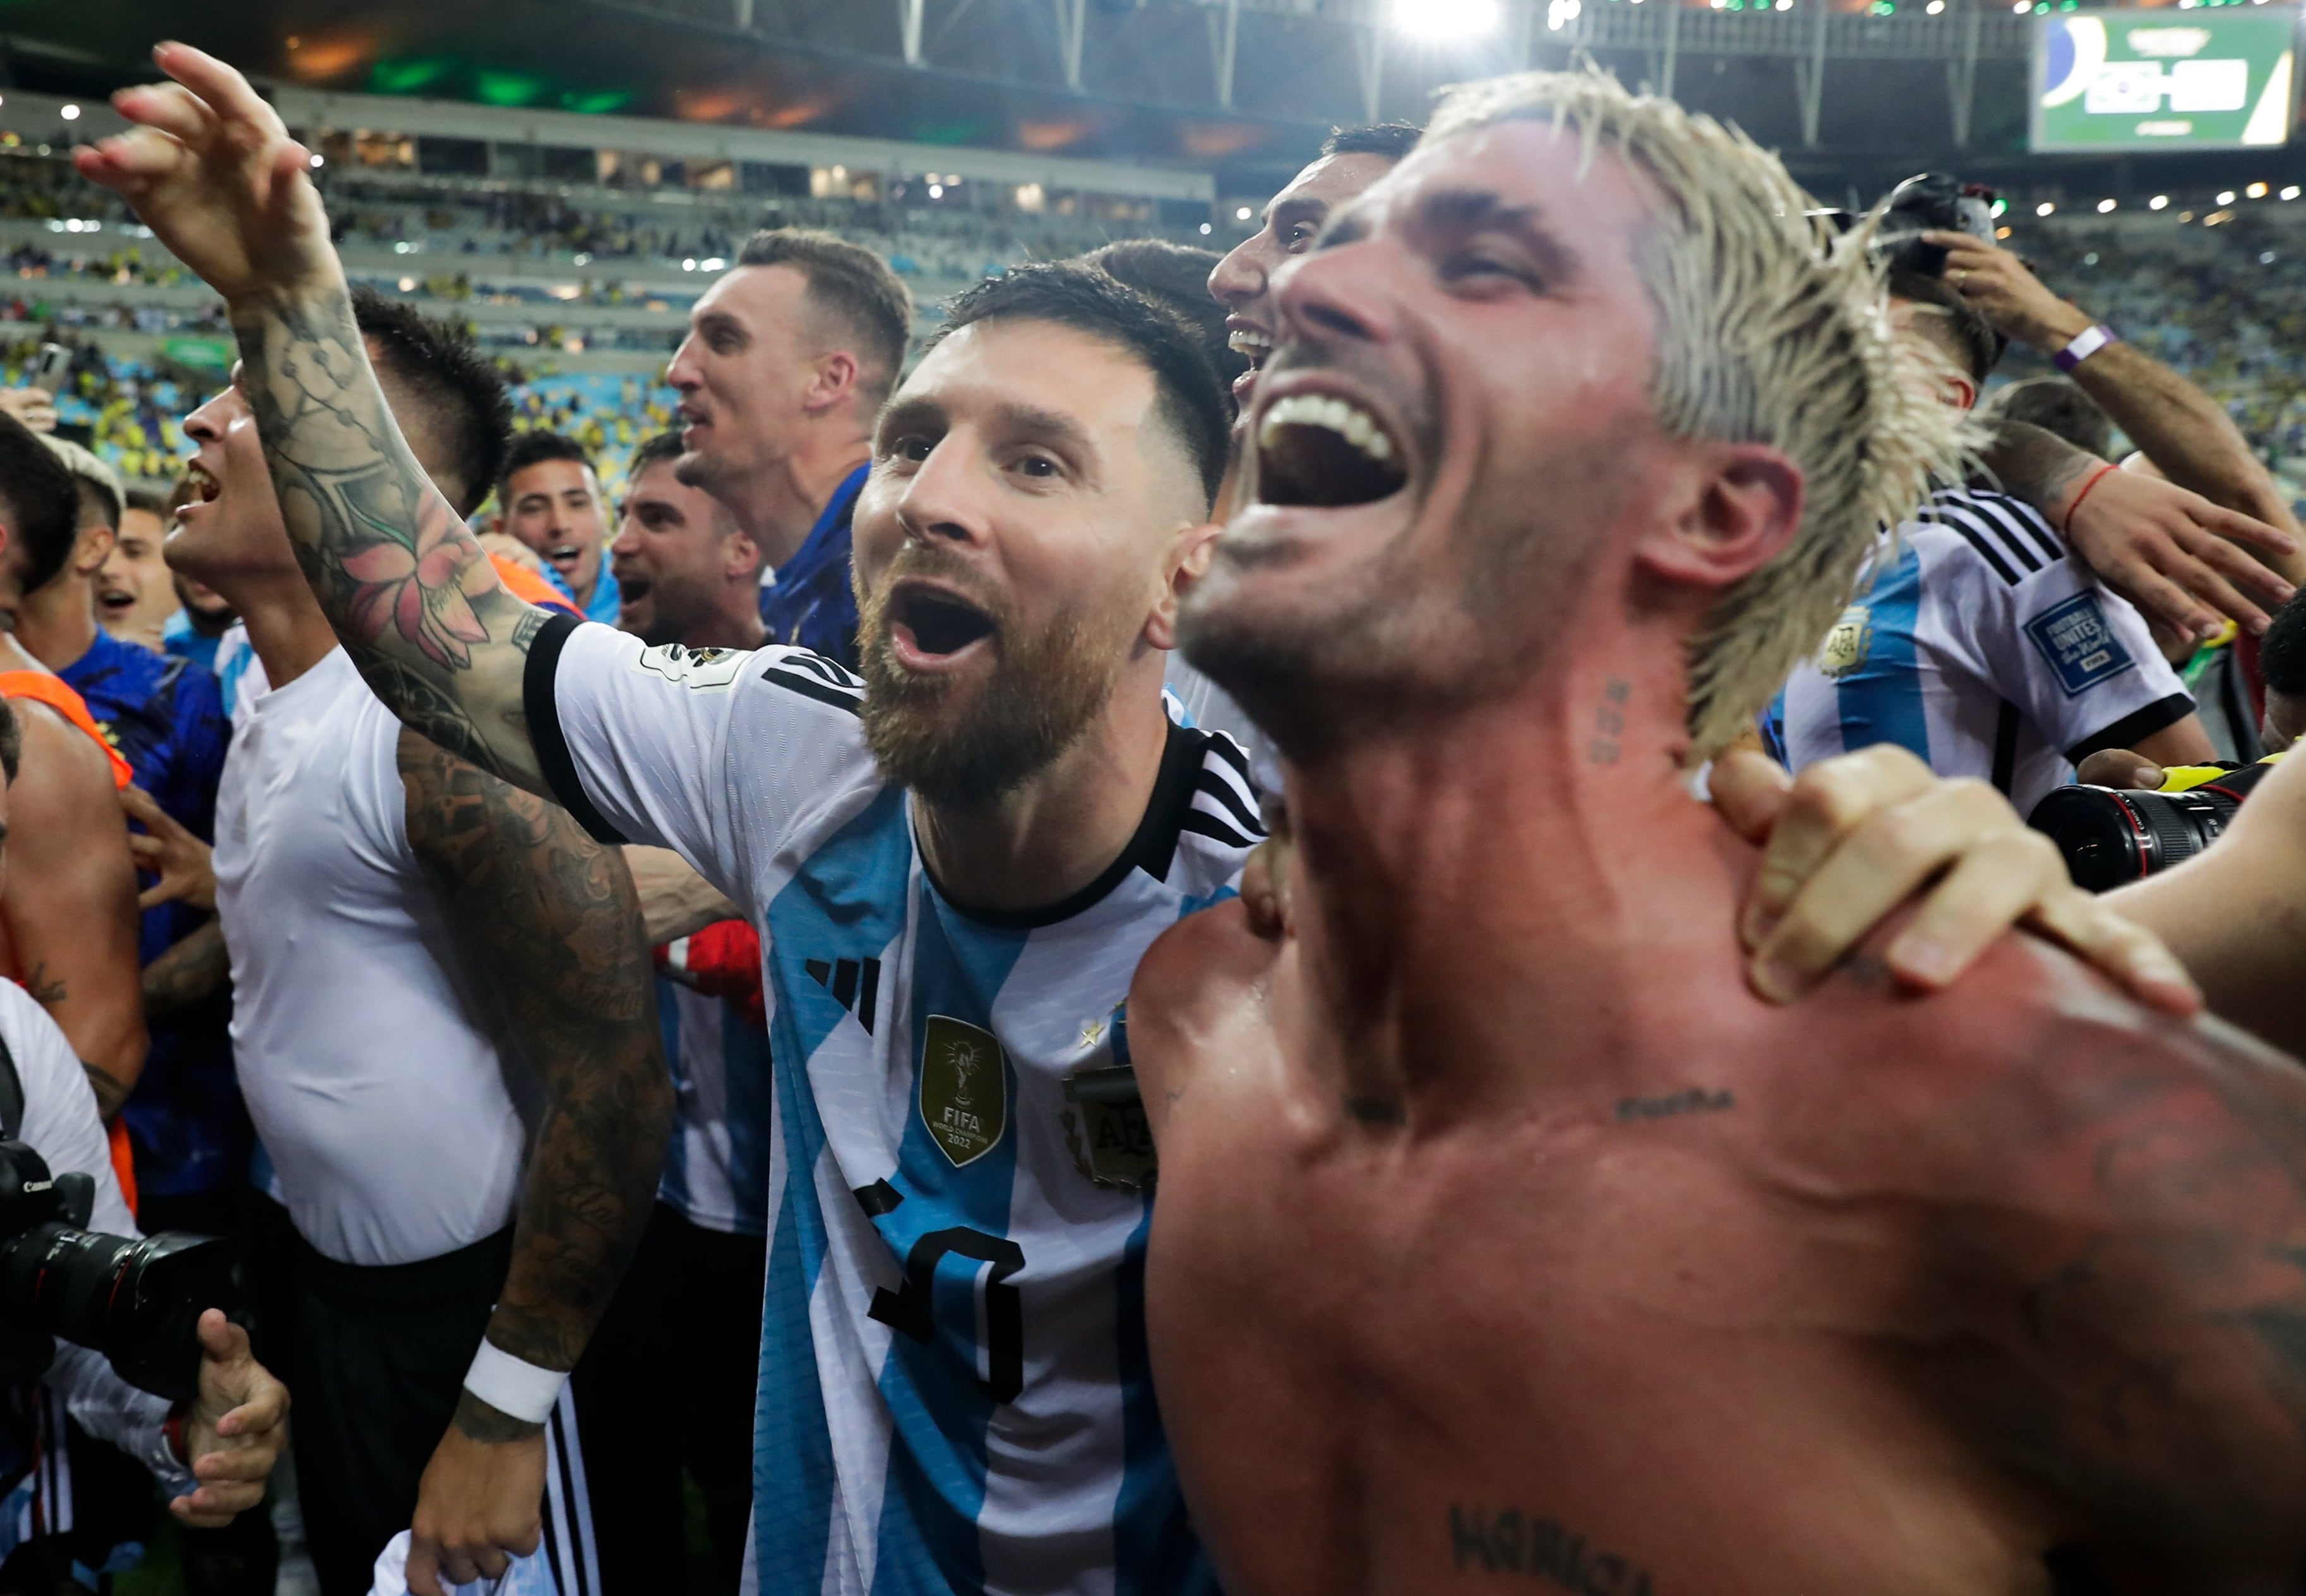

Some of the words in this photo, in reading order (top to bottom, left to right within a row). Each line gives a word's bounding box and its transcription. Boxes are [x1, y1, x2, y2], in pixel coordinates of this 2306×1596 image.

[2053, 618, 2102, 650] UNITES
[932, 1121, 954, 1133] WORLD
[943, 1106, 980, 1133] FIFA
[947, 1133, 971, 1149] 2022
[23, 1180, 52, 1193] Canon
